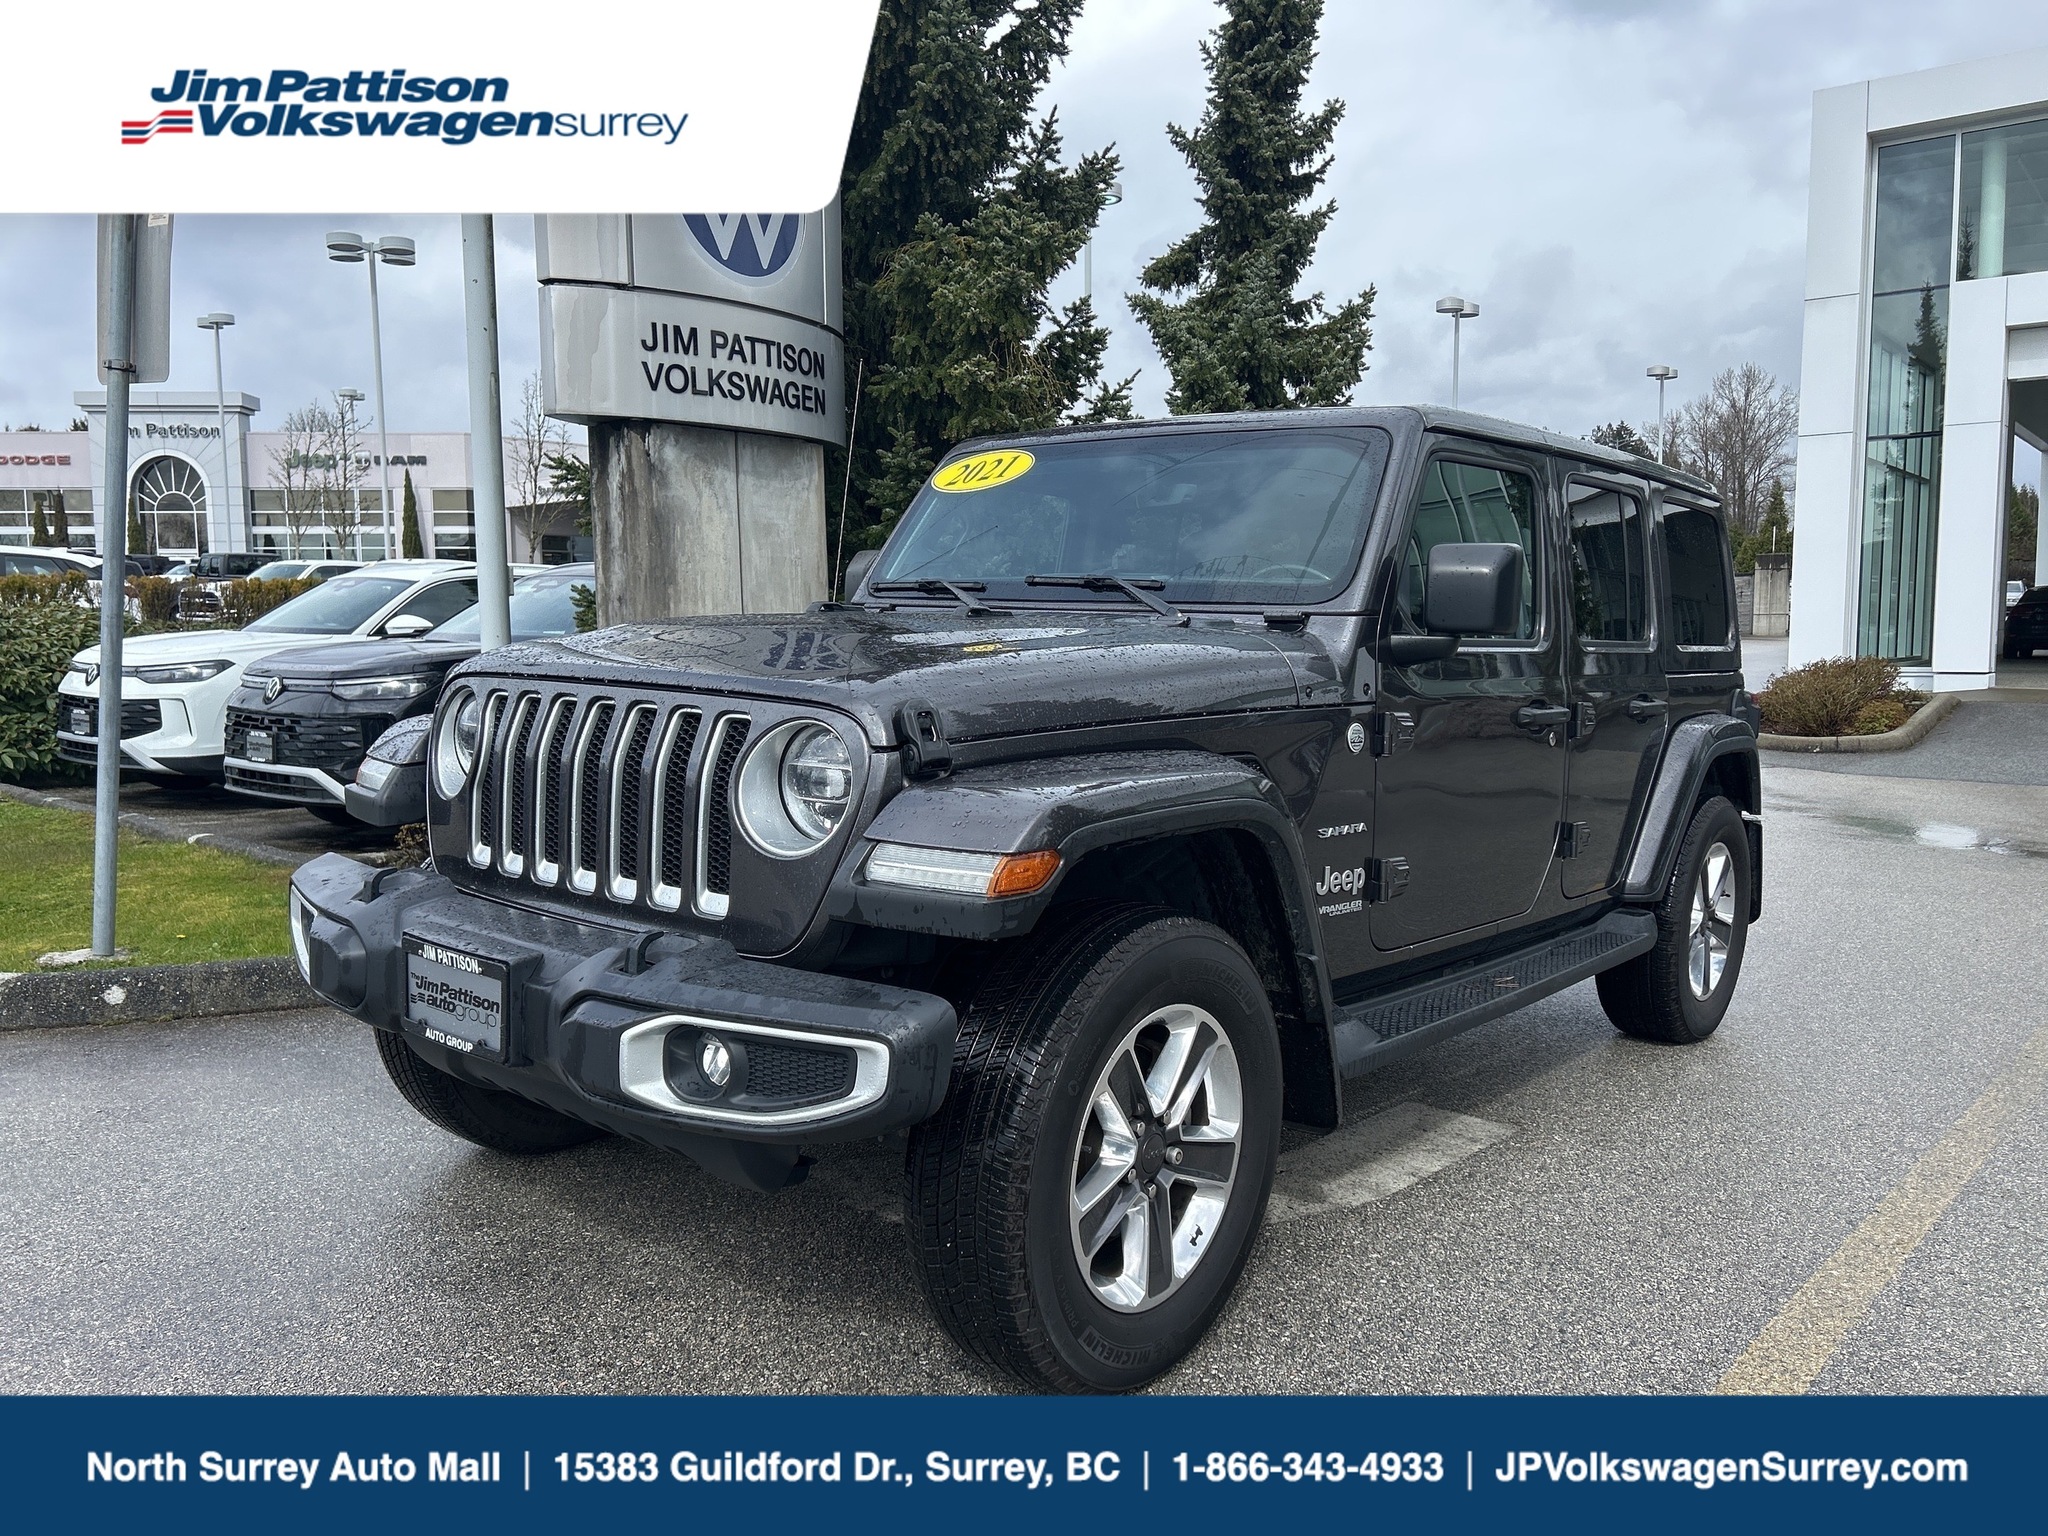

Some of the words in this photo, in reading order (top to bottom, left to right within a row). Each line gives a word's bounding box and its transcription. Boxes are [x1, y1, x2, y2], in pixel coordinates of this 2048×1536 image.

[640, 321, 699, 357] JIM
[710, 329, 826, 381] PATTISON
[640, 360, 827, 416] VOLKSWAGEN
[146, 422, 221, 438] Pattison
[943, 454, 1022, 487] 2021
[1317, 822, 1368, 839] SAHARA
[1316, 865, 1366, 896] Jeep
[1318, 899, 1362, 915] WRANGLER
[422, 944, 437, 962] JIM
[437, 947, 480, 974] PATTISON
[410, 971, 421, 981] The
[425, 1027, 445, 1044] AUTO
[445, 1035, 473, 1053] GROUP
[1083, 1329, 1153, 1366] MICHELIN
